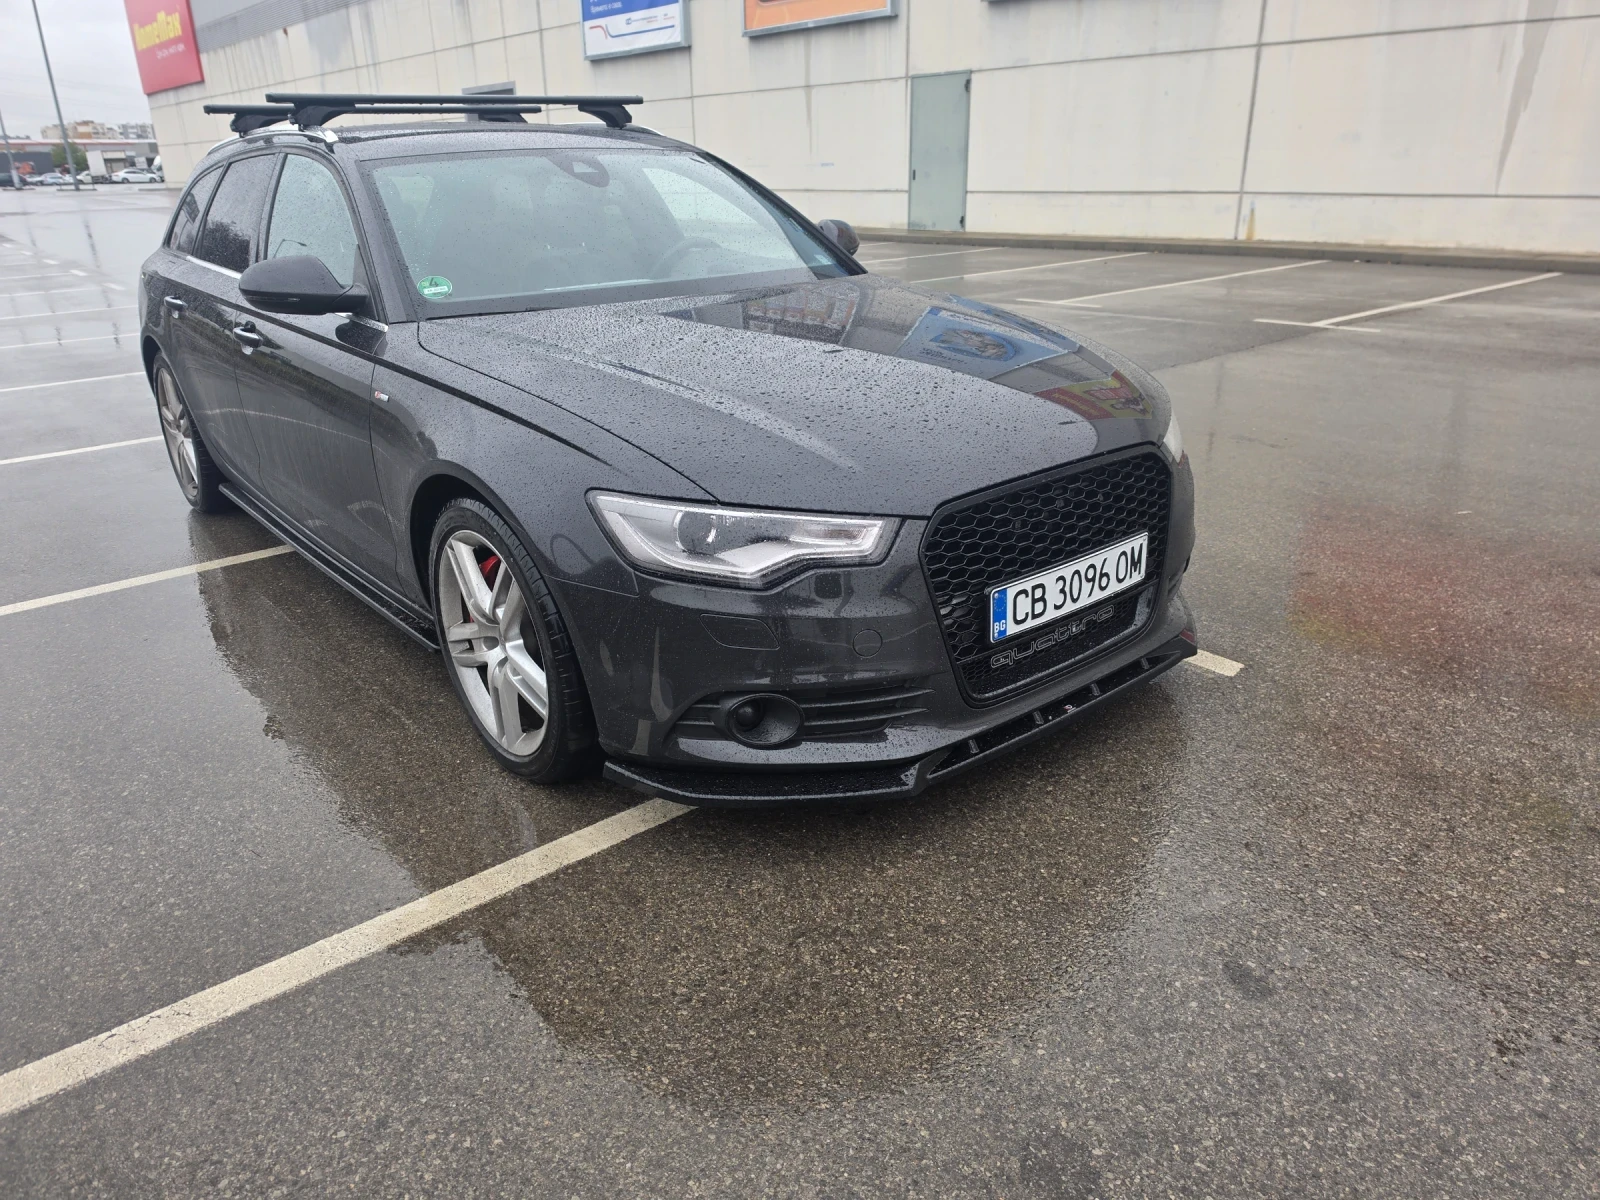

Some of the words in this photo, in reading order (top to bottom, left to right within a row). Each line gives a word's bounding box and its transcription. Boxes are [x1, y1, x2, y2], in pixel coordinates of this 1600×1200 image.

[133, 10, 182, 51] HomeMax
[1012, 582, 1048, 626] CB
[1053, 557, 1110, 611] 3096
[1115, 543, 1143, 584] OM
[991, 604, 1115, 668] quattro
[993, 620, 1006, 634] BG
